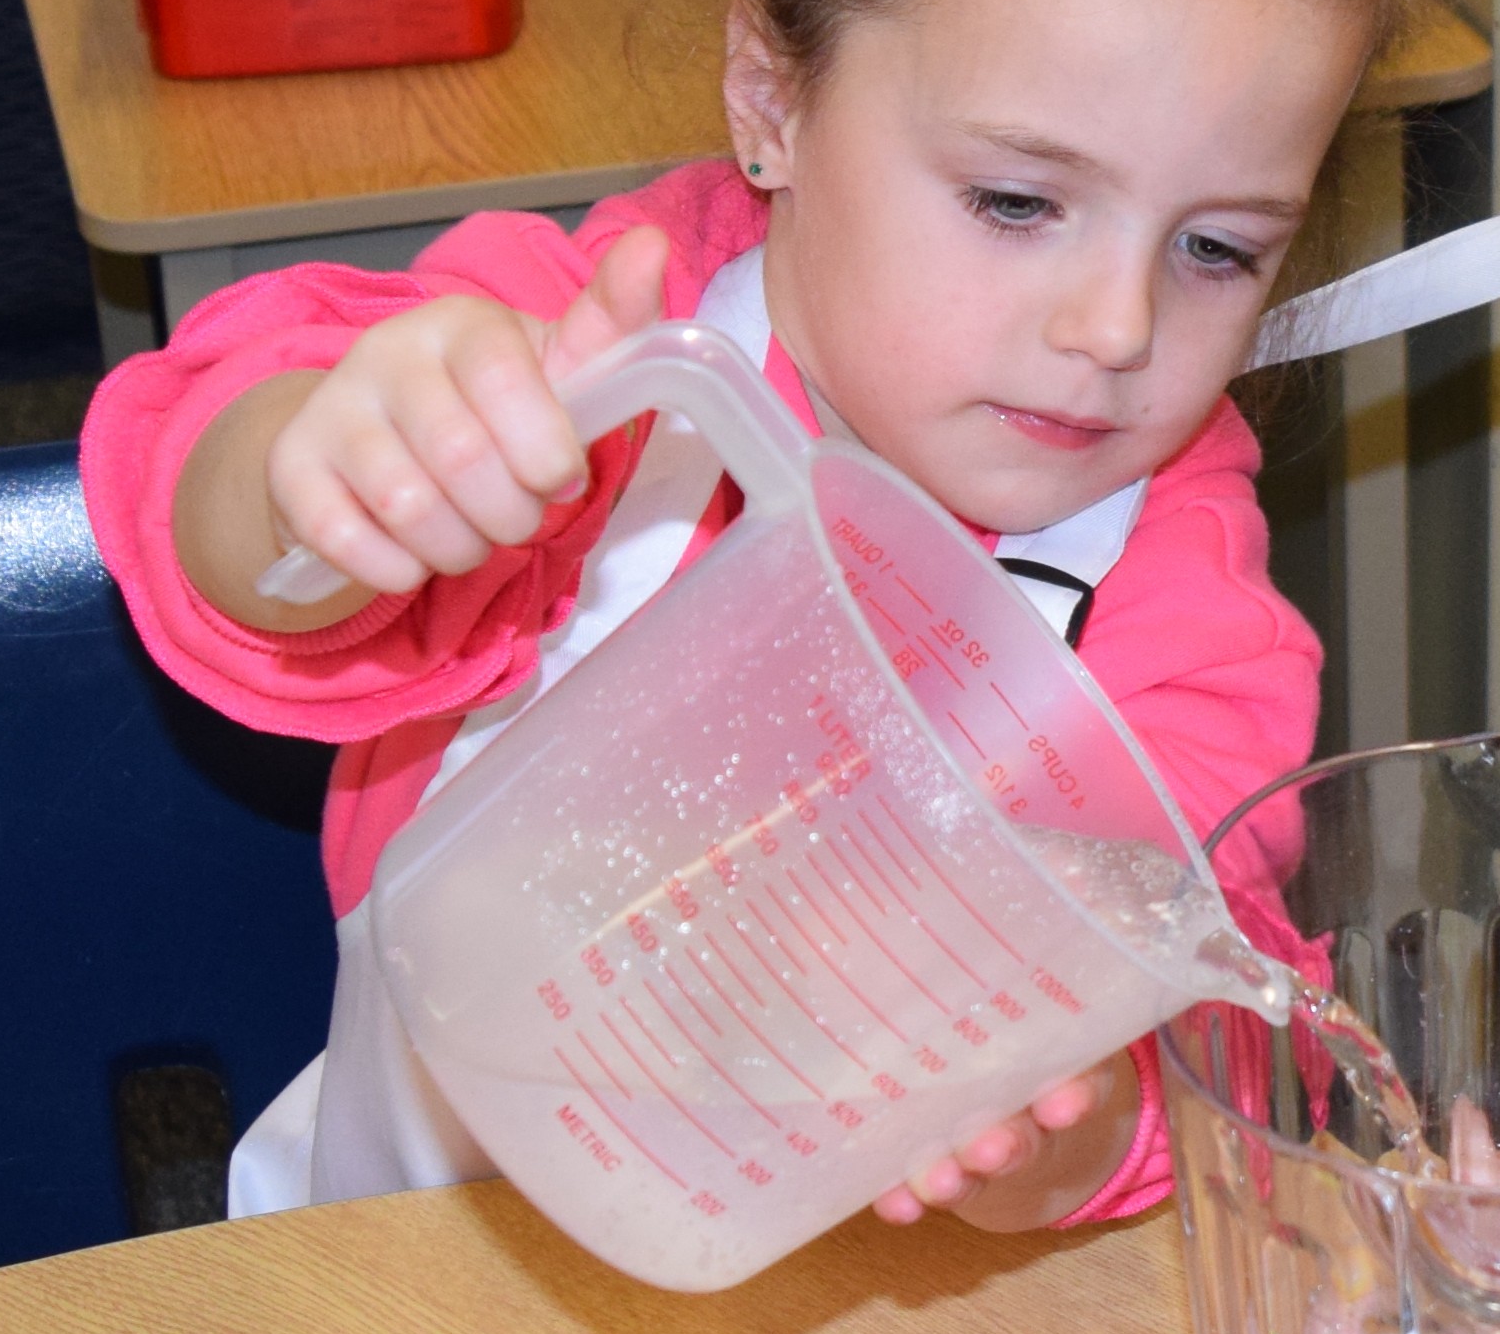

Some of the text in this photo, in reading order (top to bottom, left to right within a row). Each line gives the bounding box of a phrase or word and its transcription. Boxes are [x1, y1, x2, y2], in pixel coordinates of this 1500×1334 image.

[818, 709, 871, 783] LITER
[627, 914, 659, 953] 450
[581, 944, 615, 986] 350
[537, 978, 571, 1020] 250
[990, 991, 1026, 1021] 900
[953, 1017, 990, 1046] 800
[914, 1045, 947, 1074] 700
[872, 1072, 907, 1100] 600
[828, 1101, 864, 1128] 500
[557, 1103, 622, 1171] METRIC
[786, 1132, 818, 1156] 400
[738, 1159, 773, 1186] 300
[691, 1190, 725, 1216] 200
